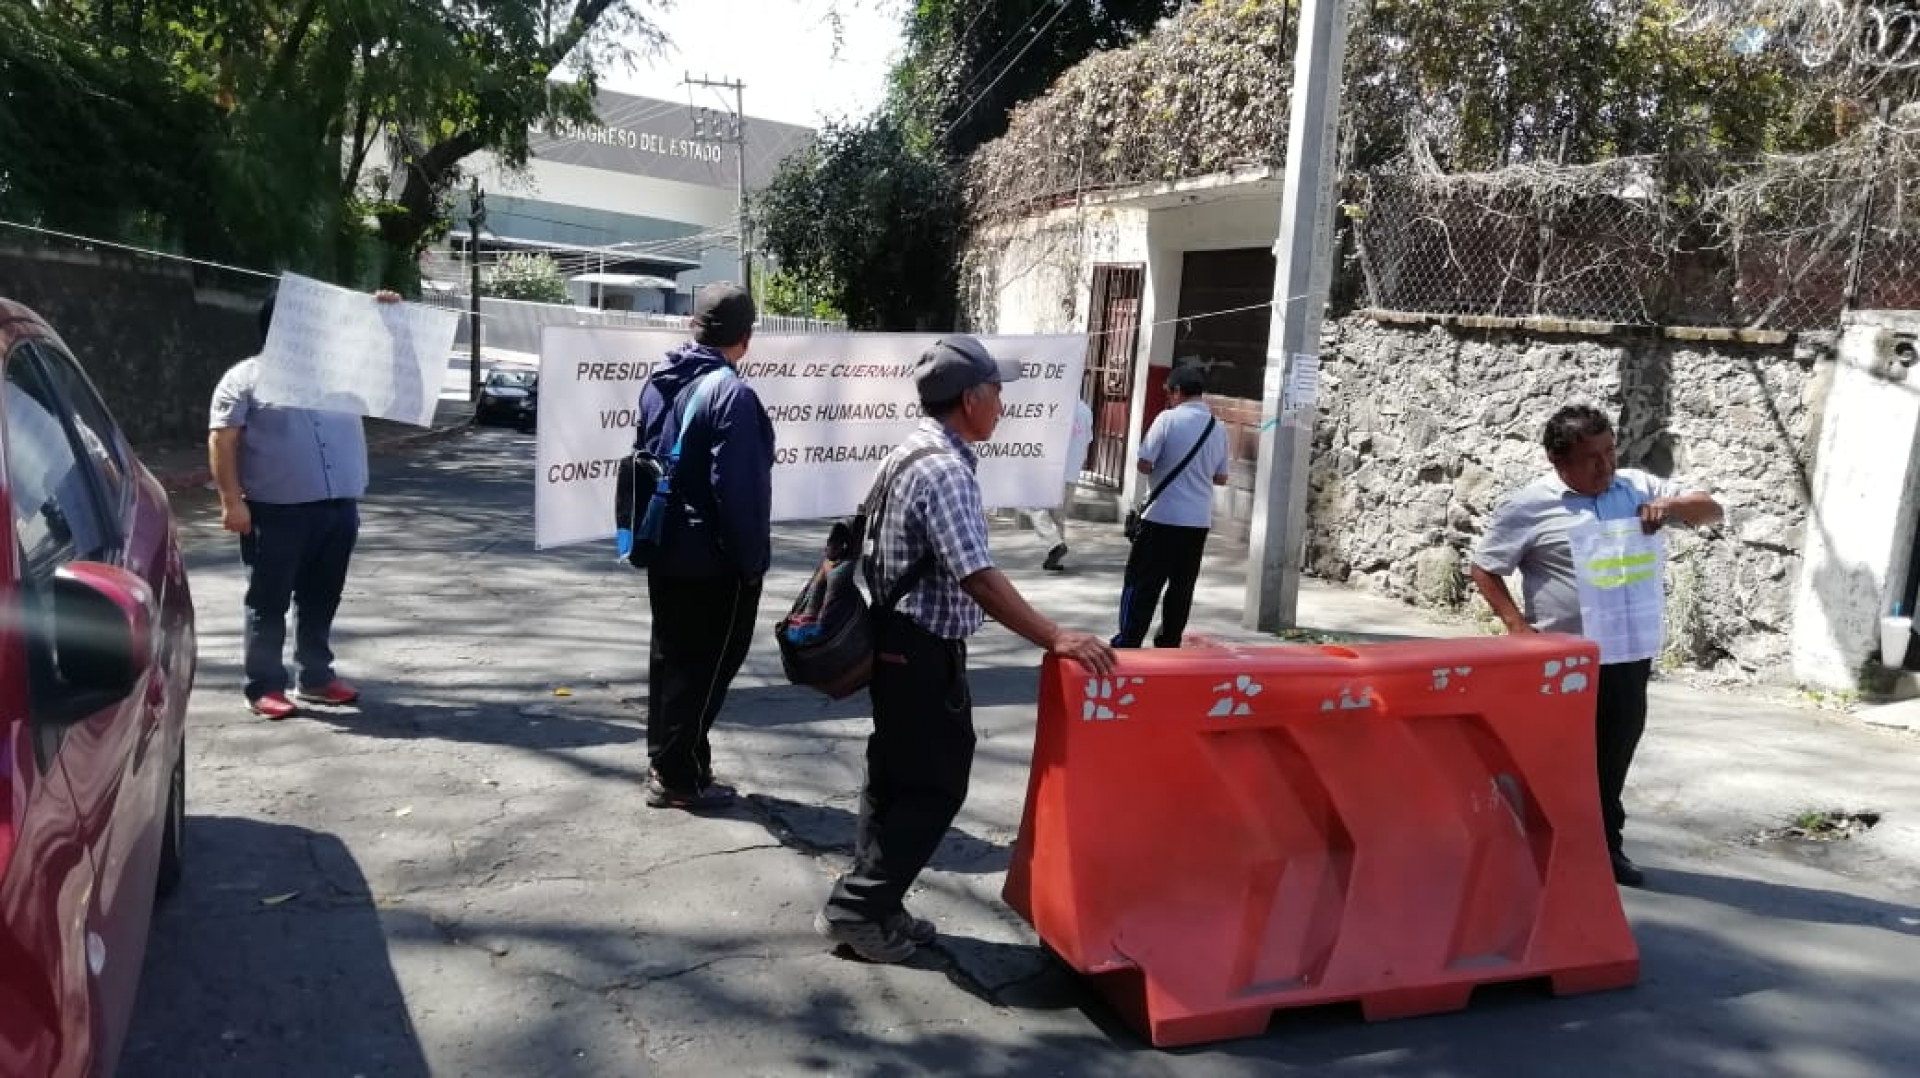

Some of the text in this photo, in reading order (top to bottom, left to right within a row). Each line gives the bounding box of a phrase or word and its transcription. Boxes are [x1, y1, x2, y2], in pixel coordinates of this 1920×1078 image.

[555, 118, 721, 163] CONGRESO DEL ESTADO
[802, 363, 829, 378] DE
[831, 364, 915, 378] CUERNAV
[1019, 363, 1041, 379] ED
[1044, 363, 1067, 379] DE
[600, 409, 642, 429] VIOL
[767, 403, 812, 422] CHOS
[815, 403, 899, 422] HUMANOS,
[1048, 403, 1059, 418] Y
[548, 442, 1045, 484] CONSTI OS TRABAJAD IONADOS.
